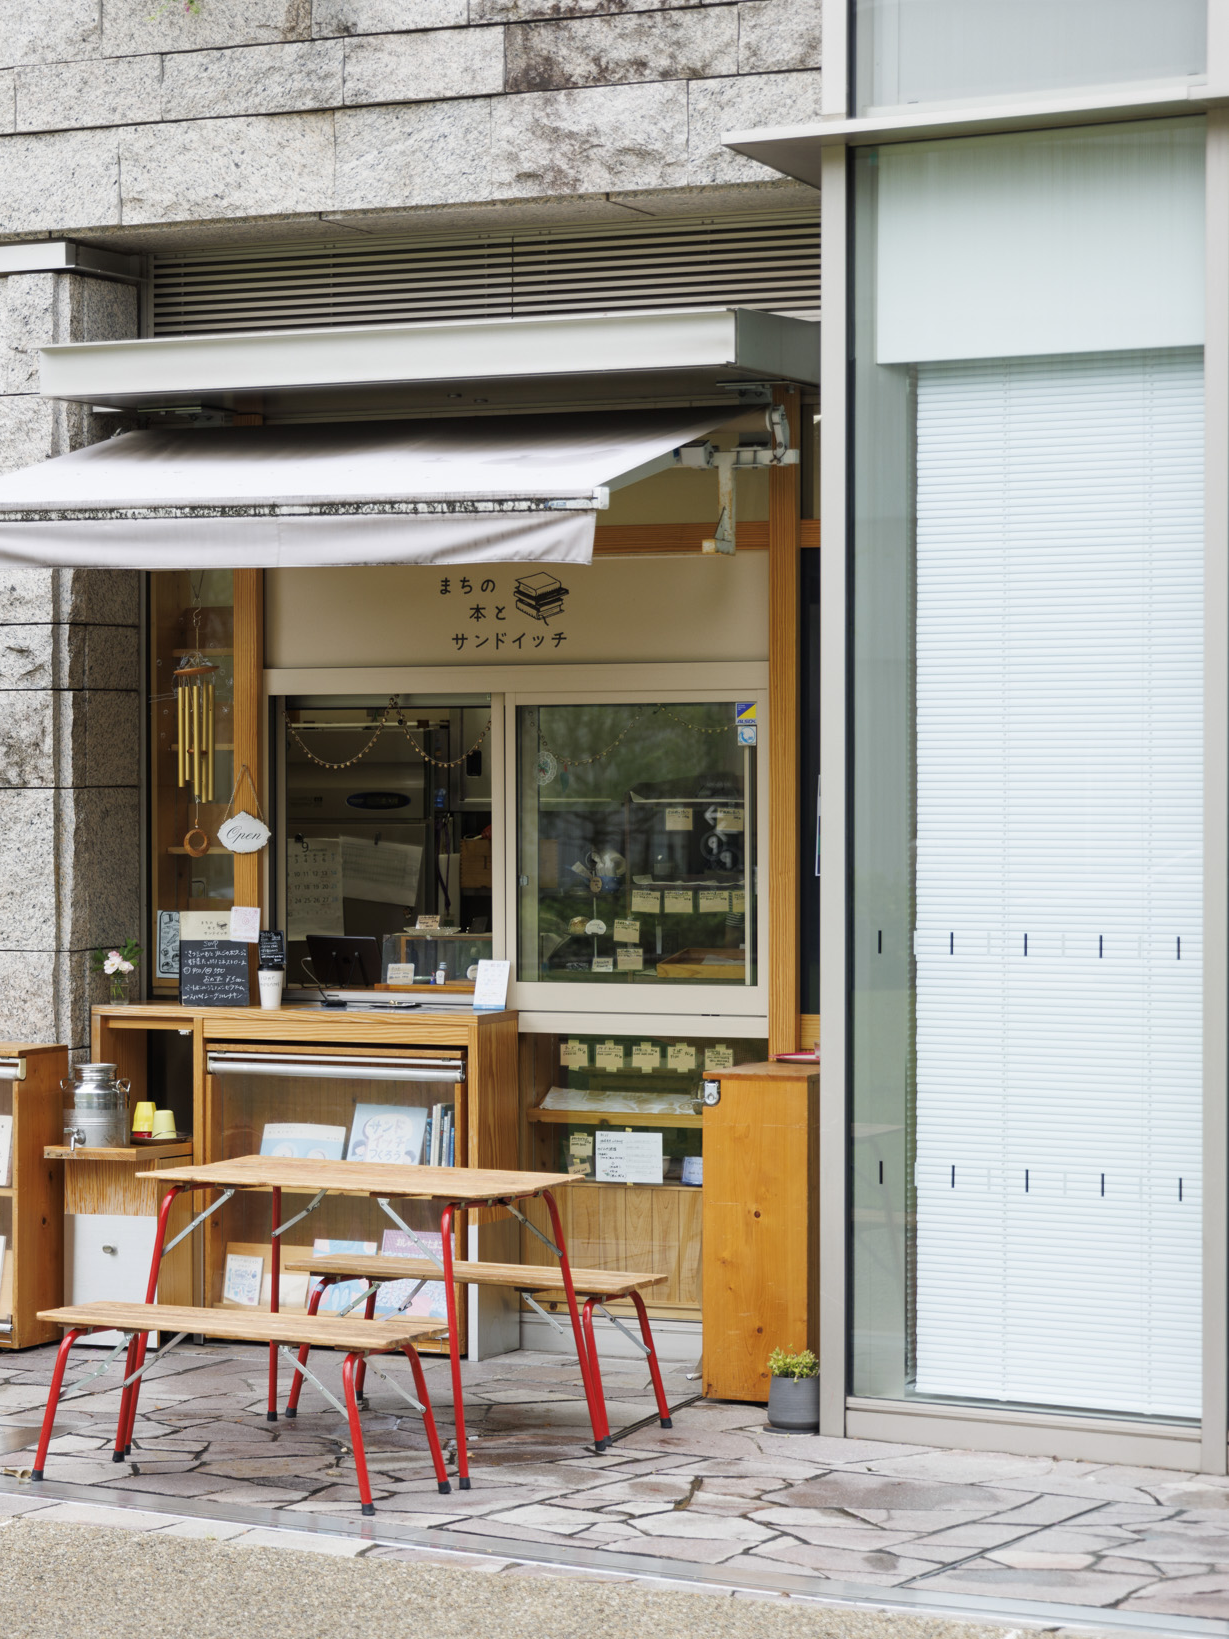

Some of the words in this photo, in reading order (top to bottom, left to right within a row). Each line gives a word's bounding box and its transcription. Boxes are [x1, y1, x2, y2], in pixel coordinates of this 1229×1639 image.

[440, 576, 496, 595] まちの
[470, 604, 506, 622] 本と
[452, 632, 568, 650] サンドイッチ
[226, 826, 262, 844] Open
[302, 842, 308, 852] 9
[369, 1118, 406, 1134] サンド
